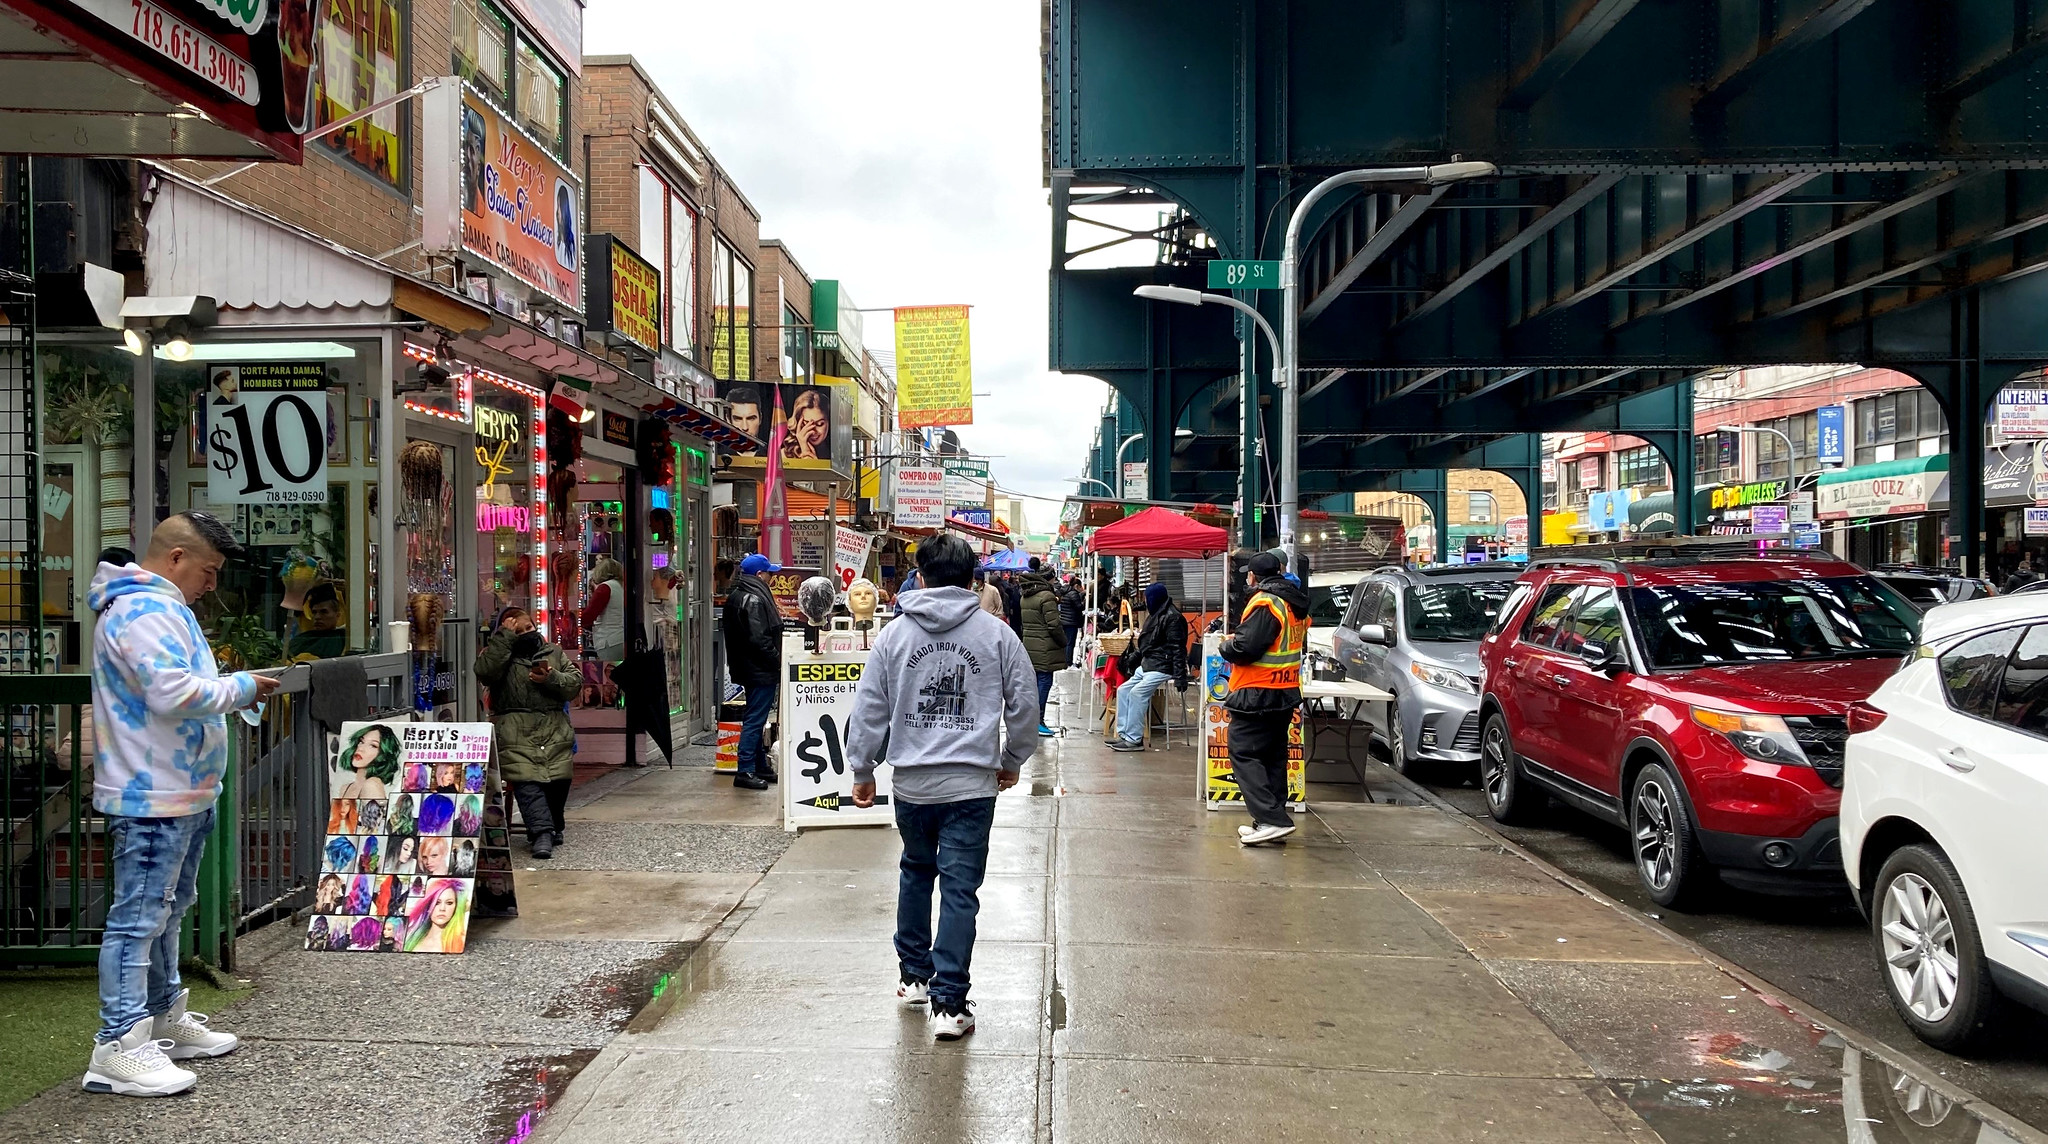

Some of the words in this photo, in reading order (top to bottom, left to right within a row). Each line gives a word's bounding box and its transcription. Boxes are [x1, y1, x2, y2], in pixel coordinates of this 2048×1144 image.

[132, 0, 246, 97] 718.651.3905
[497, 132, 547, 197] Mery's
[485, 164, 517, 226] Salon
[516, 187, 554, 249] Unisex
[495, 241, 542, 284] CABALLEROS
[612, 246, 642, 283] CLASES
[644, 269, 655, 292] DE
[1227, 264, 1247, 285] 89
[1253, 265, 1264, 277] St
[612, 269, 649, 321] OSHA
[816, 335, 821, 347] 2
[822, 334, 838, 348] PISO
[240, 366, 268, 375] CORTE
[270, 366, 290, 375] PARA
[293, 366, 324, 376] DAMAS,
[244, 379, 282, 388] HOMBRES
[284, 379, 290, 388] Y
[292, 377, 318, 388] NIÑOS
[209, 394, 324, 495] $10
[899, 471, 927, 480] COMPRO
[928, 472, 942, 481] ORO
[266, 492, 280, 502] 718
[282, 492, 324, 502] 429-0590
[1740, 482, 1776, 506] WIRELESS
[1833, 487, 1848, 503] EL
[920, 498, 942, 506] PERUANA
[836, 536, 866, 550] PERUANA
[837, 530, 868, 544] EUGENIA
[838, 543, 862, 554] UNISEX
[906, 643, 934, 669] TIRADO
[936, 642, 958, 652] IRON
[958, 646, 981, 674] WORKS
[796, 684, 830, 694] Cortes
[833, 683, 846, 693] de
[796, 696, 802, 706] y
[806, 694, 835, 704] Niños
[403, 727, 459, 742] Mery's
[405, 742, 432, 750] Unisex
[434, 742, 457, 750] Salon
[456, 752, 487, 760] 10:00PM
[814, 796, 839, 808] Aqui
